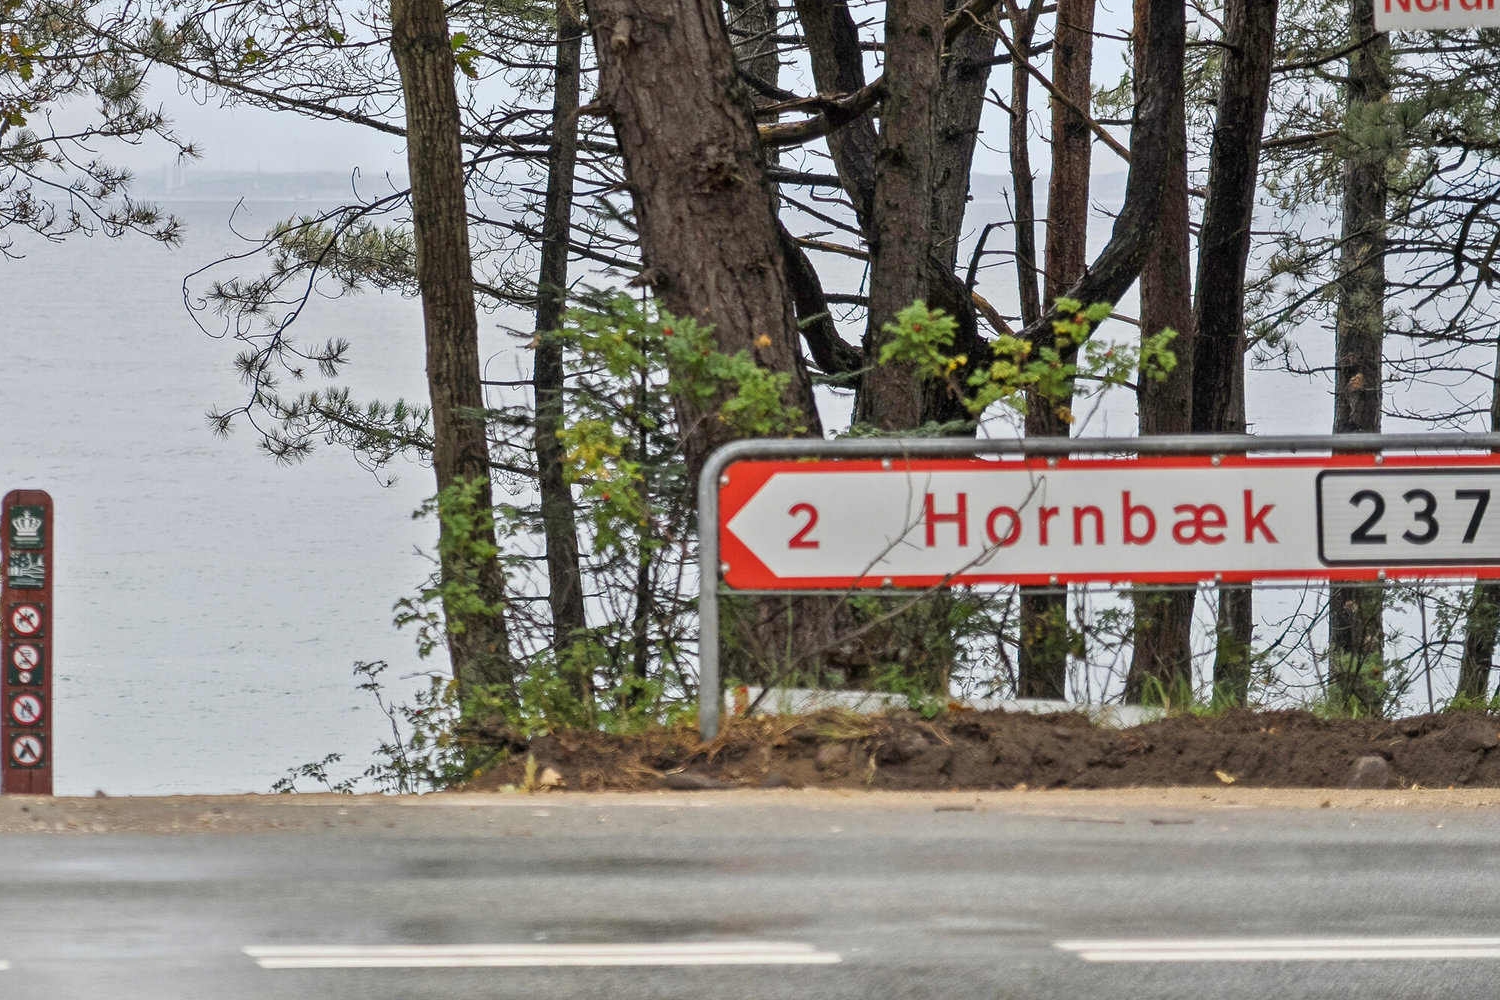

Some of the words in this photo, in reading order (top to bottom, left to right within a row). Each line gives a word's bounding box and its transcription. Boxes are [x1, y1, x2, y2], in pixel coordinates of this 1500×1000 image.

[788, 502, 820, 549] 2
[924, 489, 1279, 547] Hornbæk
[1349, 488, 1491, 545] 237
